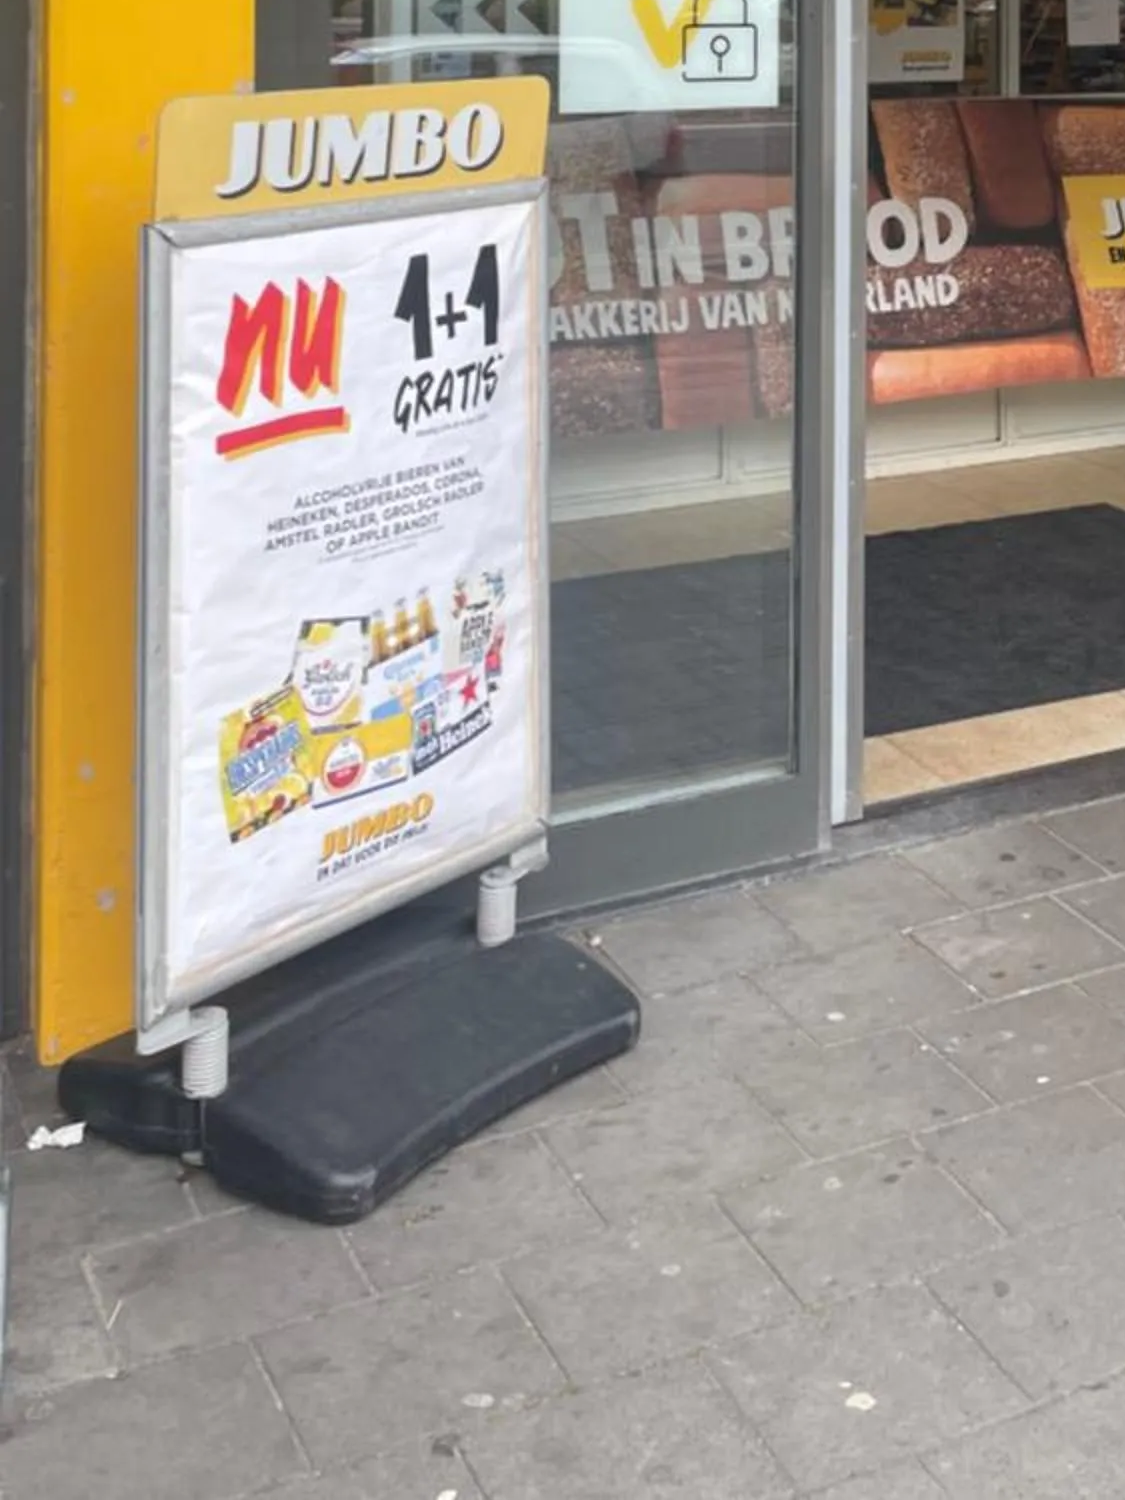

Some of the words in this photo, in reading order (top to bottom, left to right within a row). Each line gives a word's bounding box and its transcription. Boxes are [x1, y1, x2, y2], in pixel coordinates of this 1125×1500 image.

[215, 102, 503, 200] JUMBO
[631, 215, 703, 288] IN
[549, 299, 690, 342] AKKERIJ
[699, 291, 769, 330] VAN
[264, 529, 319, 551] AMSTEL
[383, 495, 442, 521] GROLSCH
[444, 481, 485, 503] RADLER
[294, 474, 392, 510] ALCOHOLVRIJE
[396, 462, 440, 485] BIEREN
[444, 456, 465, 471] VAN
[326, 538, 345, 554] OF
[349, 524, 390, 547] APPLE
[393, 511, 440, 535] BANDIT
[319, 793, 434, 864] JUMBO
